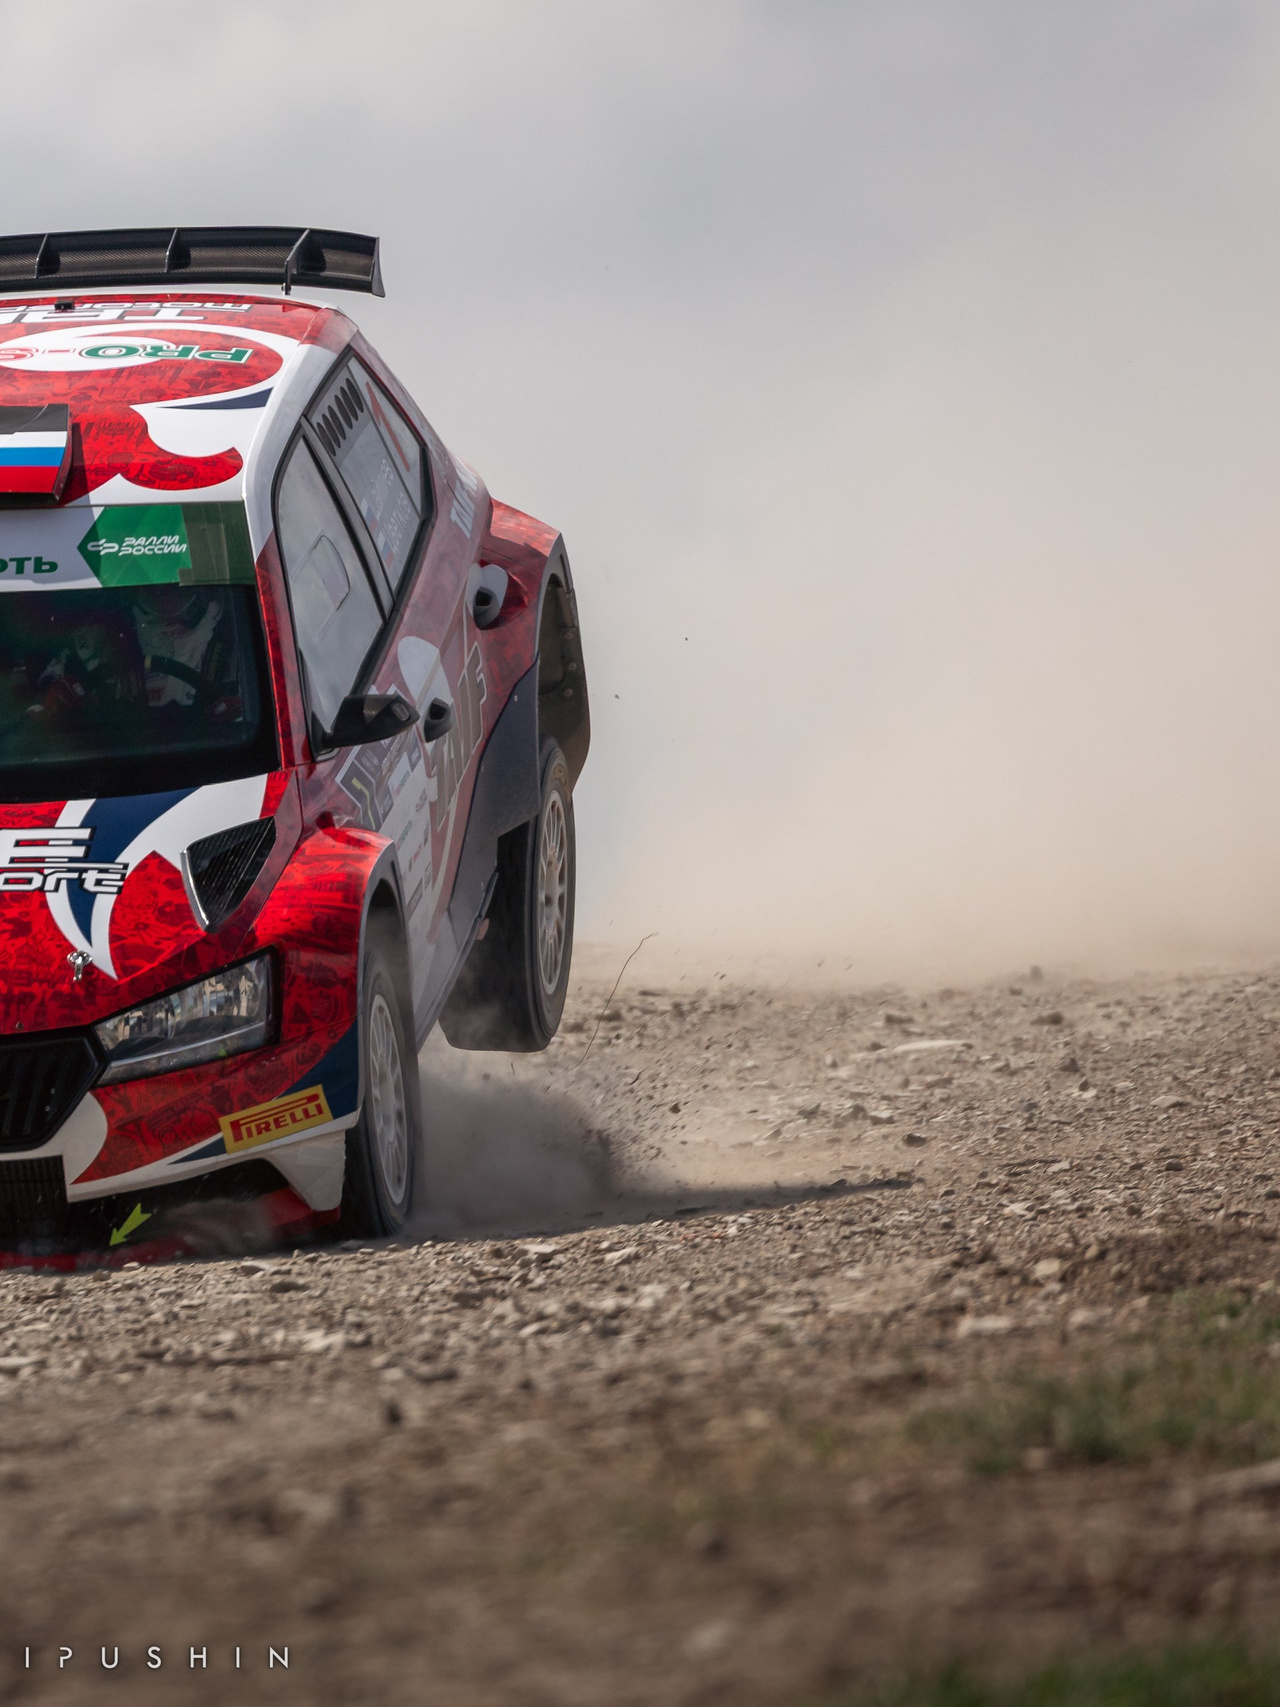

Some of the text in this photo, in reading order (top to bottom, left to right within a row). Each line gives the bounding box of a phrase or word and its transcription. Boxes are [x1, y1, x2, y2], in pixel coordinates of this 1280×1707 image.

[122, 535, 180, 547] РАЛЛИ
[118, 543, 187, 556] РОССИИ
[229, 1093, 324, 1143] PIRELLI
